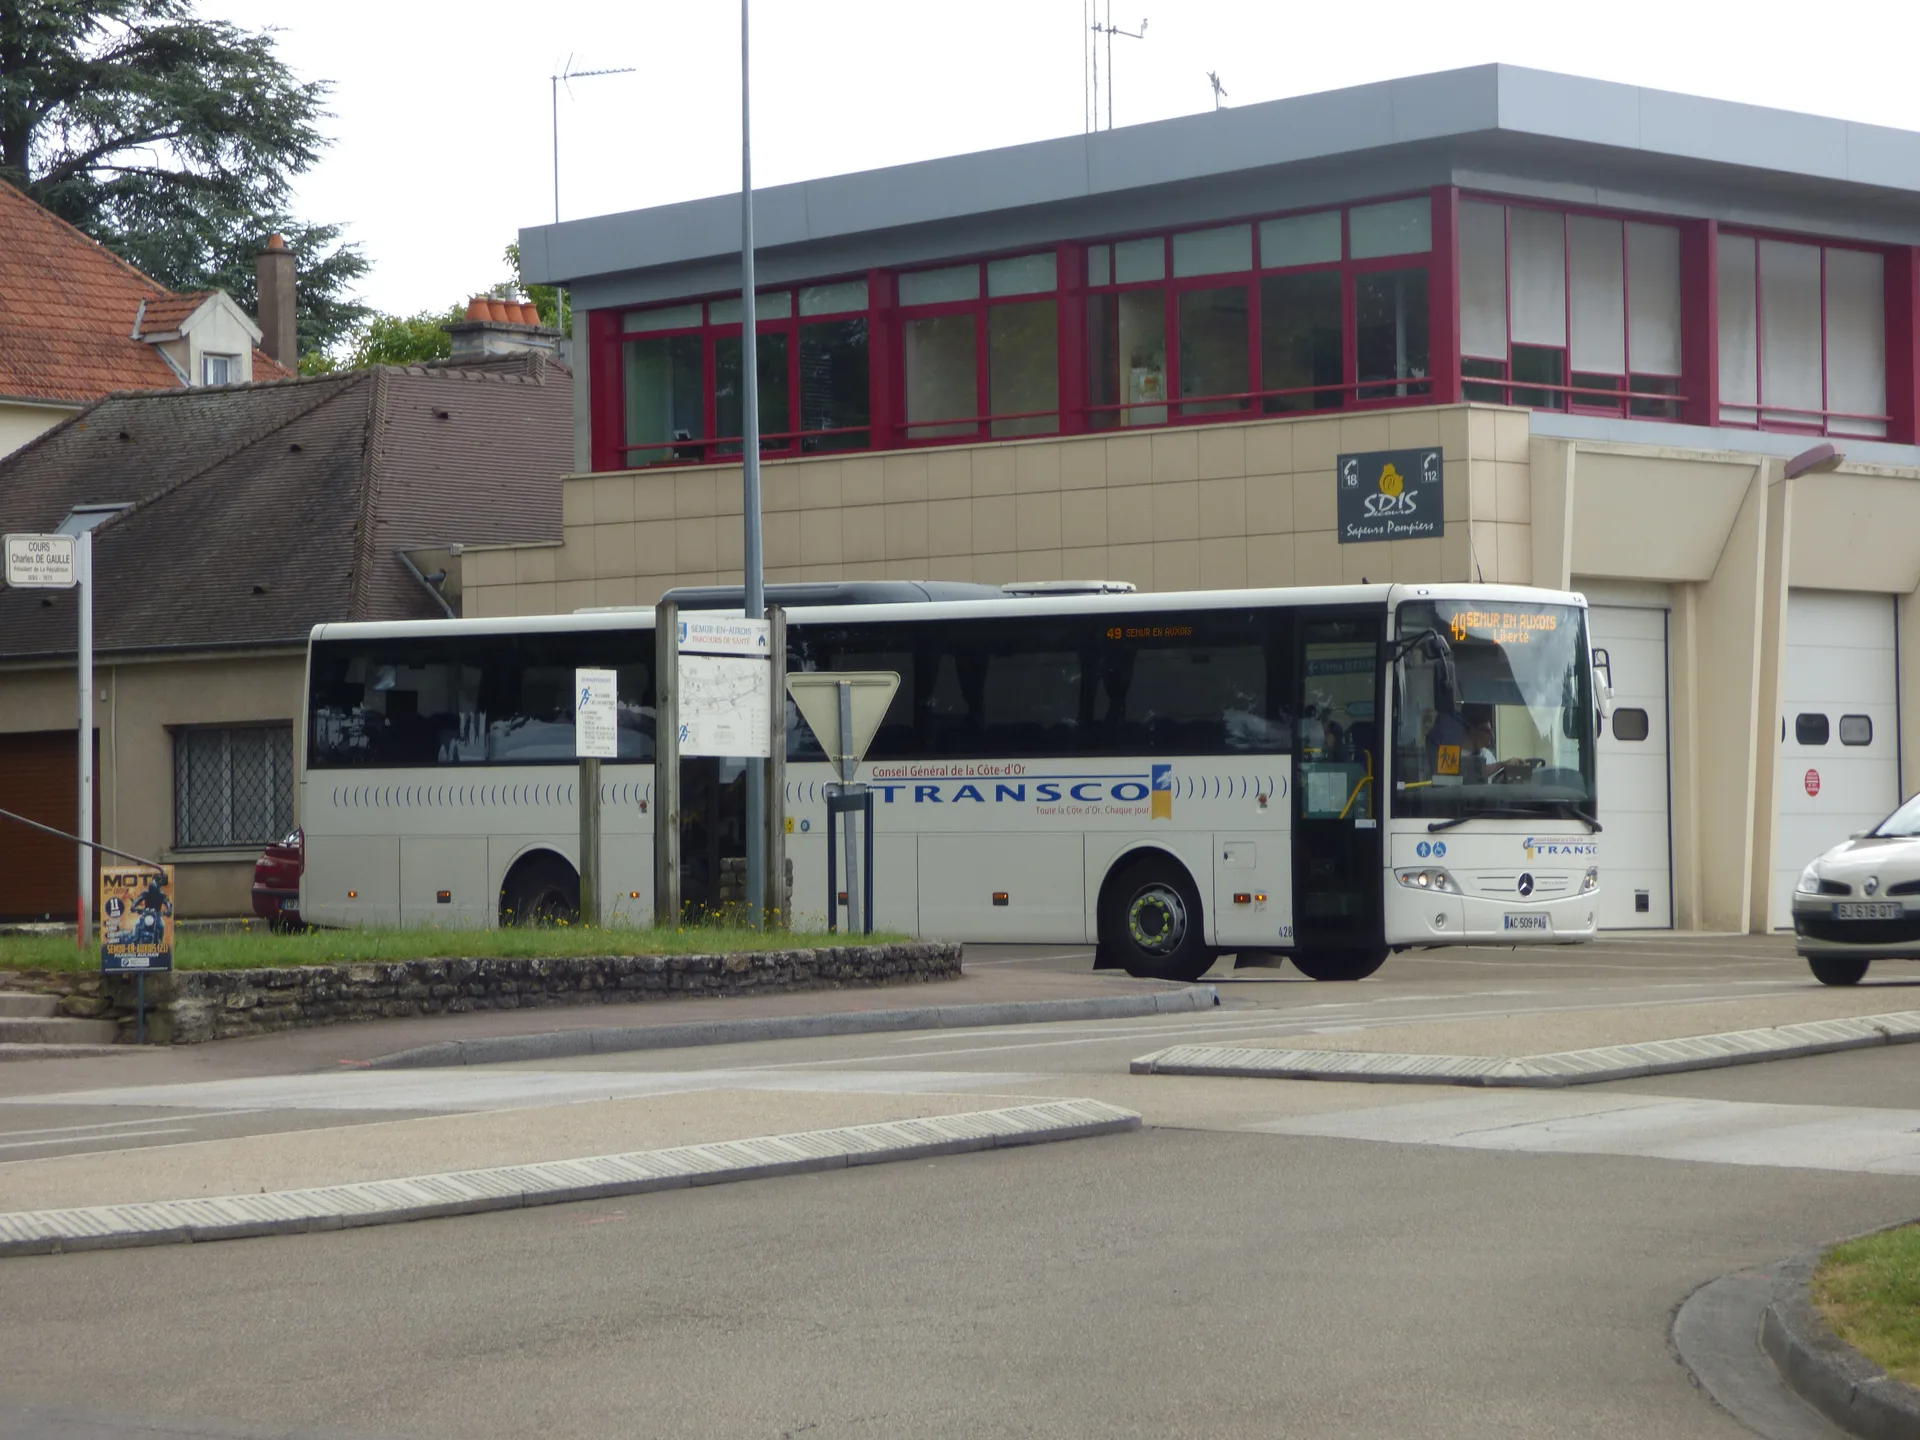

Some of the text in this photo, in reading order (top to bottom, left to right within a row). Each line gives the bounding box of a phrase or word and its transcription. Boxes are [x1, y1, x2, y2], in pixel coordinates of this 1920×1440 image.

[1345, 474, 1358, 486] 18
[1424, 471, 1437, 482] 112
[1364, 490, 1418, 518] SDIS
[1347, 520, 1434, 539] Sapeurs Pompiers
[28, 541, 51, 552] COURS
[11, 553, 70, 564] Charles DE GAULLE
[1466, 611, 1500, 628] SEMUR
[1502, 613, 1516, 629] EN
[1519, 614, 1556, 630] AUXOIS
[1106, 626, 1192, 639] 49 SEMUR EN AUXOIS
[692, 635, 723, 644] PARCOURS
[872, 766, 908, 777] Conseil
[910, 765, 948, 777] Général
[951, 765, 963, 776] de
[965, 764, 974, 776] la
[871, 783, 1150, 803] TRANSCO
[1036, 806, 1056, 815] Toute
[1058, 805, 1065, 815] la
[1066, 805, 1081, 815] Côte
[1105, 805, 1132, 816] Chaque
[1134, 806, 1149, 816] jour
[1278, 926, 1293, 938] 428
